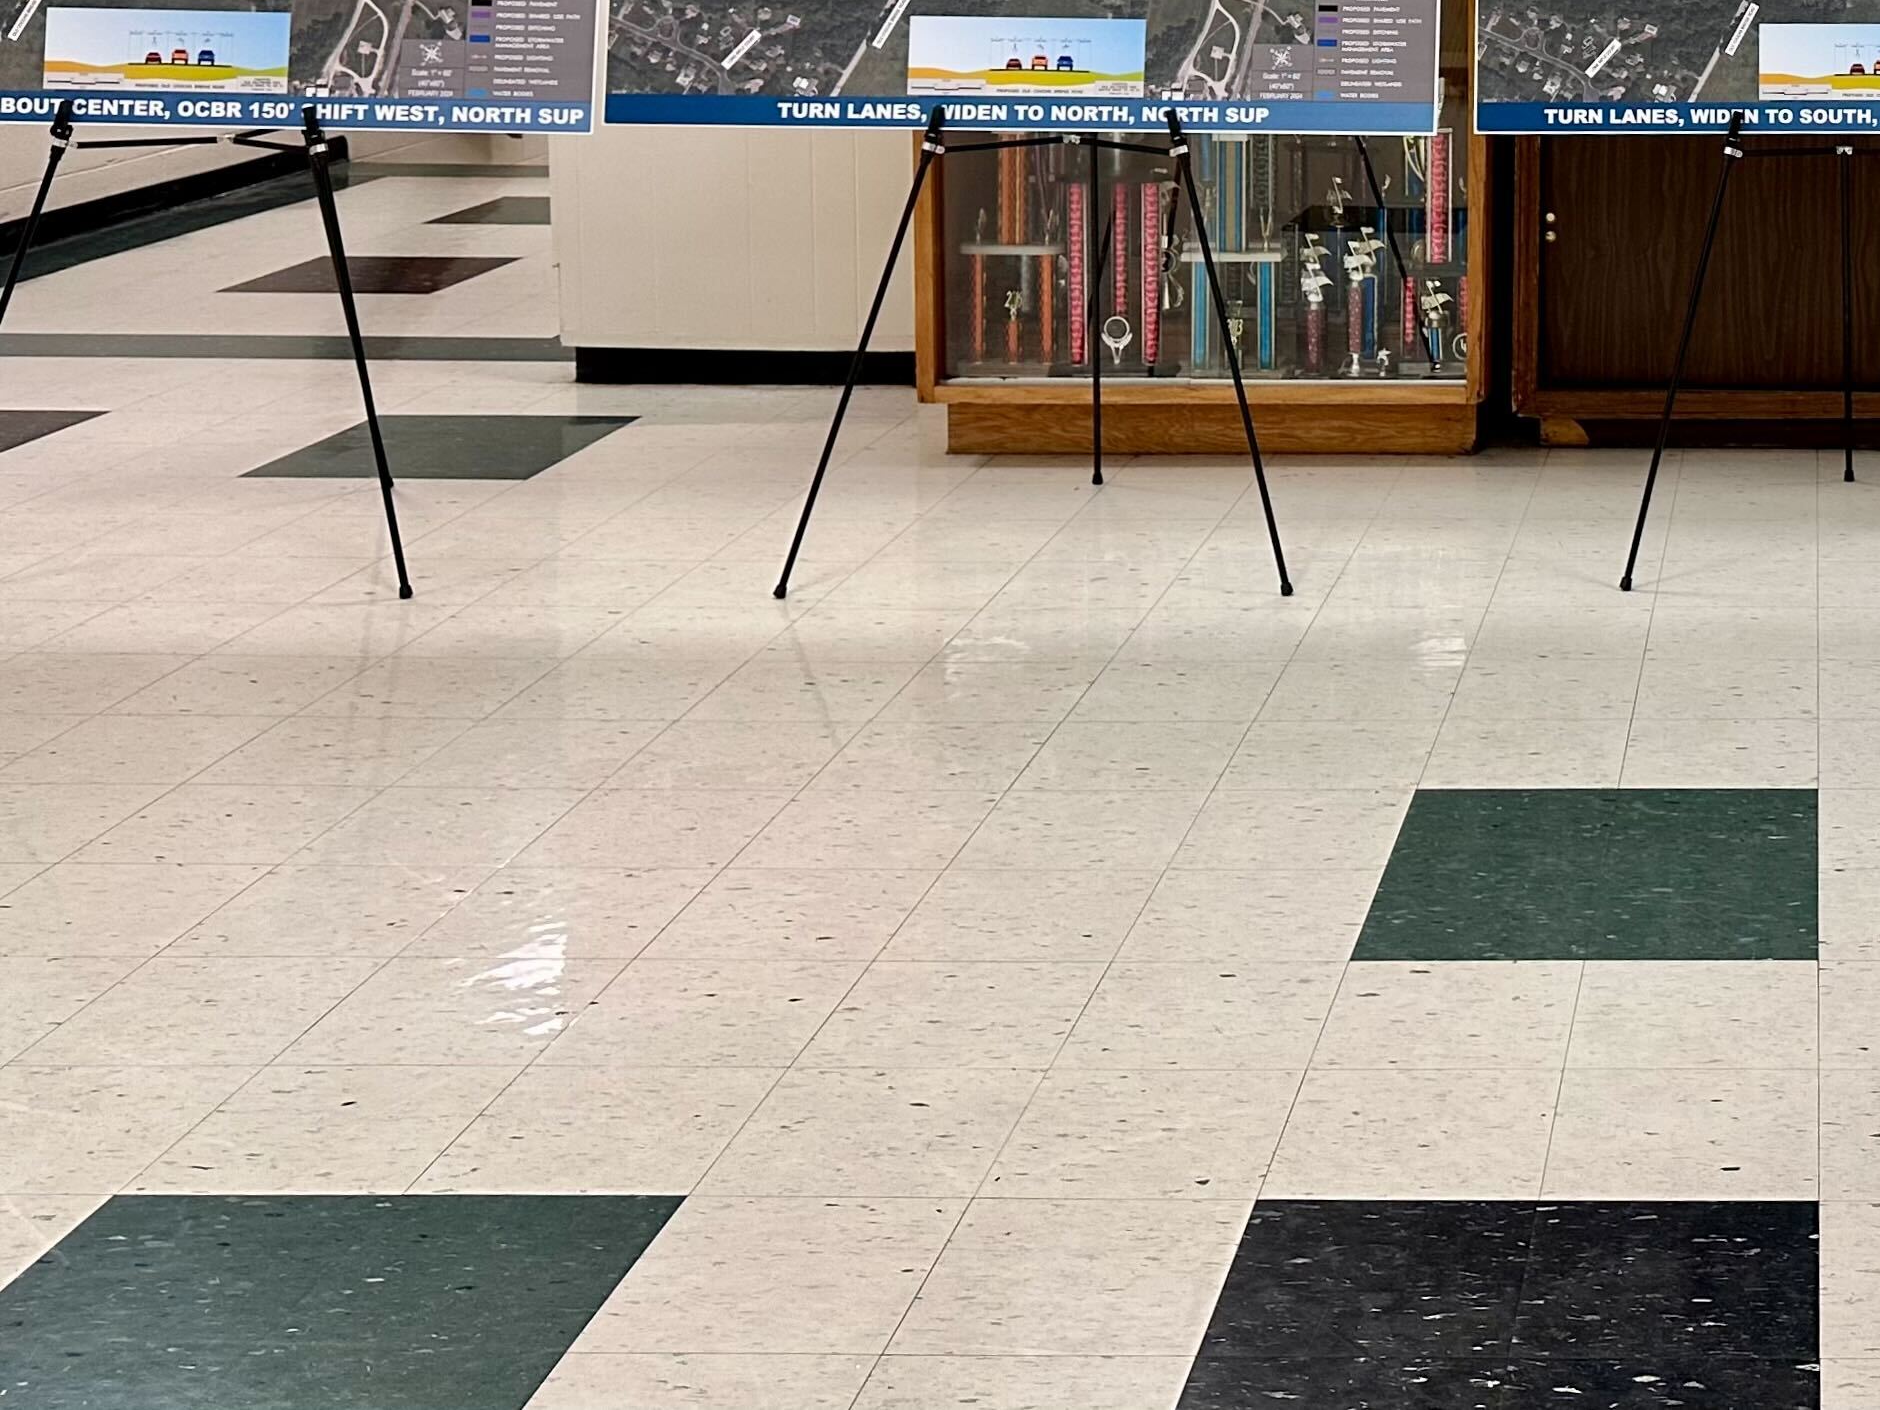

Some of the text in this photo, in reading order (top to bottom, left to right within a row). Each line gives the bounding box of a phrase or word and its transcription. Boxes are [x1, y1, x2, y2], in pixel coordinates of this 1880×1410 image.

[72, 99, 170, 120] CENTER,
[177, 101, 242, 118] OCBR
[249, 102, 294, 118] 150'
[301, 103, 368, 120] HIFT
[374, 105, 445, 125] WEST,
[452, 107, 532, 124] NORTH
[538, 109, 584, 124] SUP
[777, 102, 840, 119] TURN
[847, 103, 927, 123] LANES,
[1014, 105, 1044, 121] TO
[1051, 106, 1134, 125] NORTH,
[1225, 107, 1269, 123] SUP
[1544, 109, 1603, 124] TURN
[1609, 109, 1684, 127] LANES,
[1765, 109, 1793, 124] TO
[1799, 109, 1878, 127] SOUTH,
